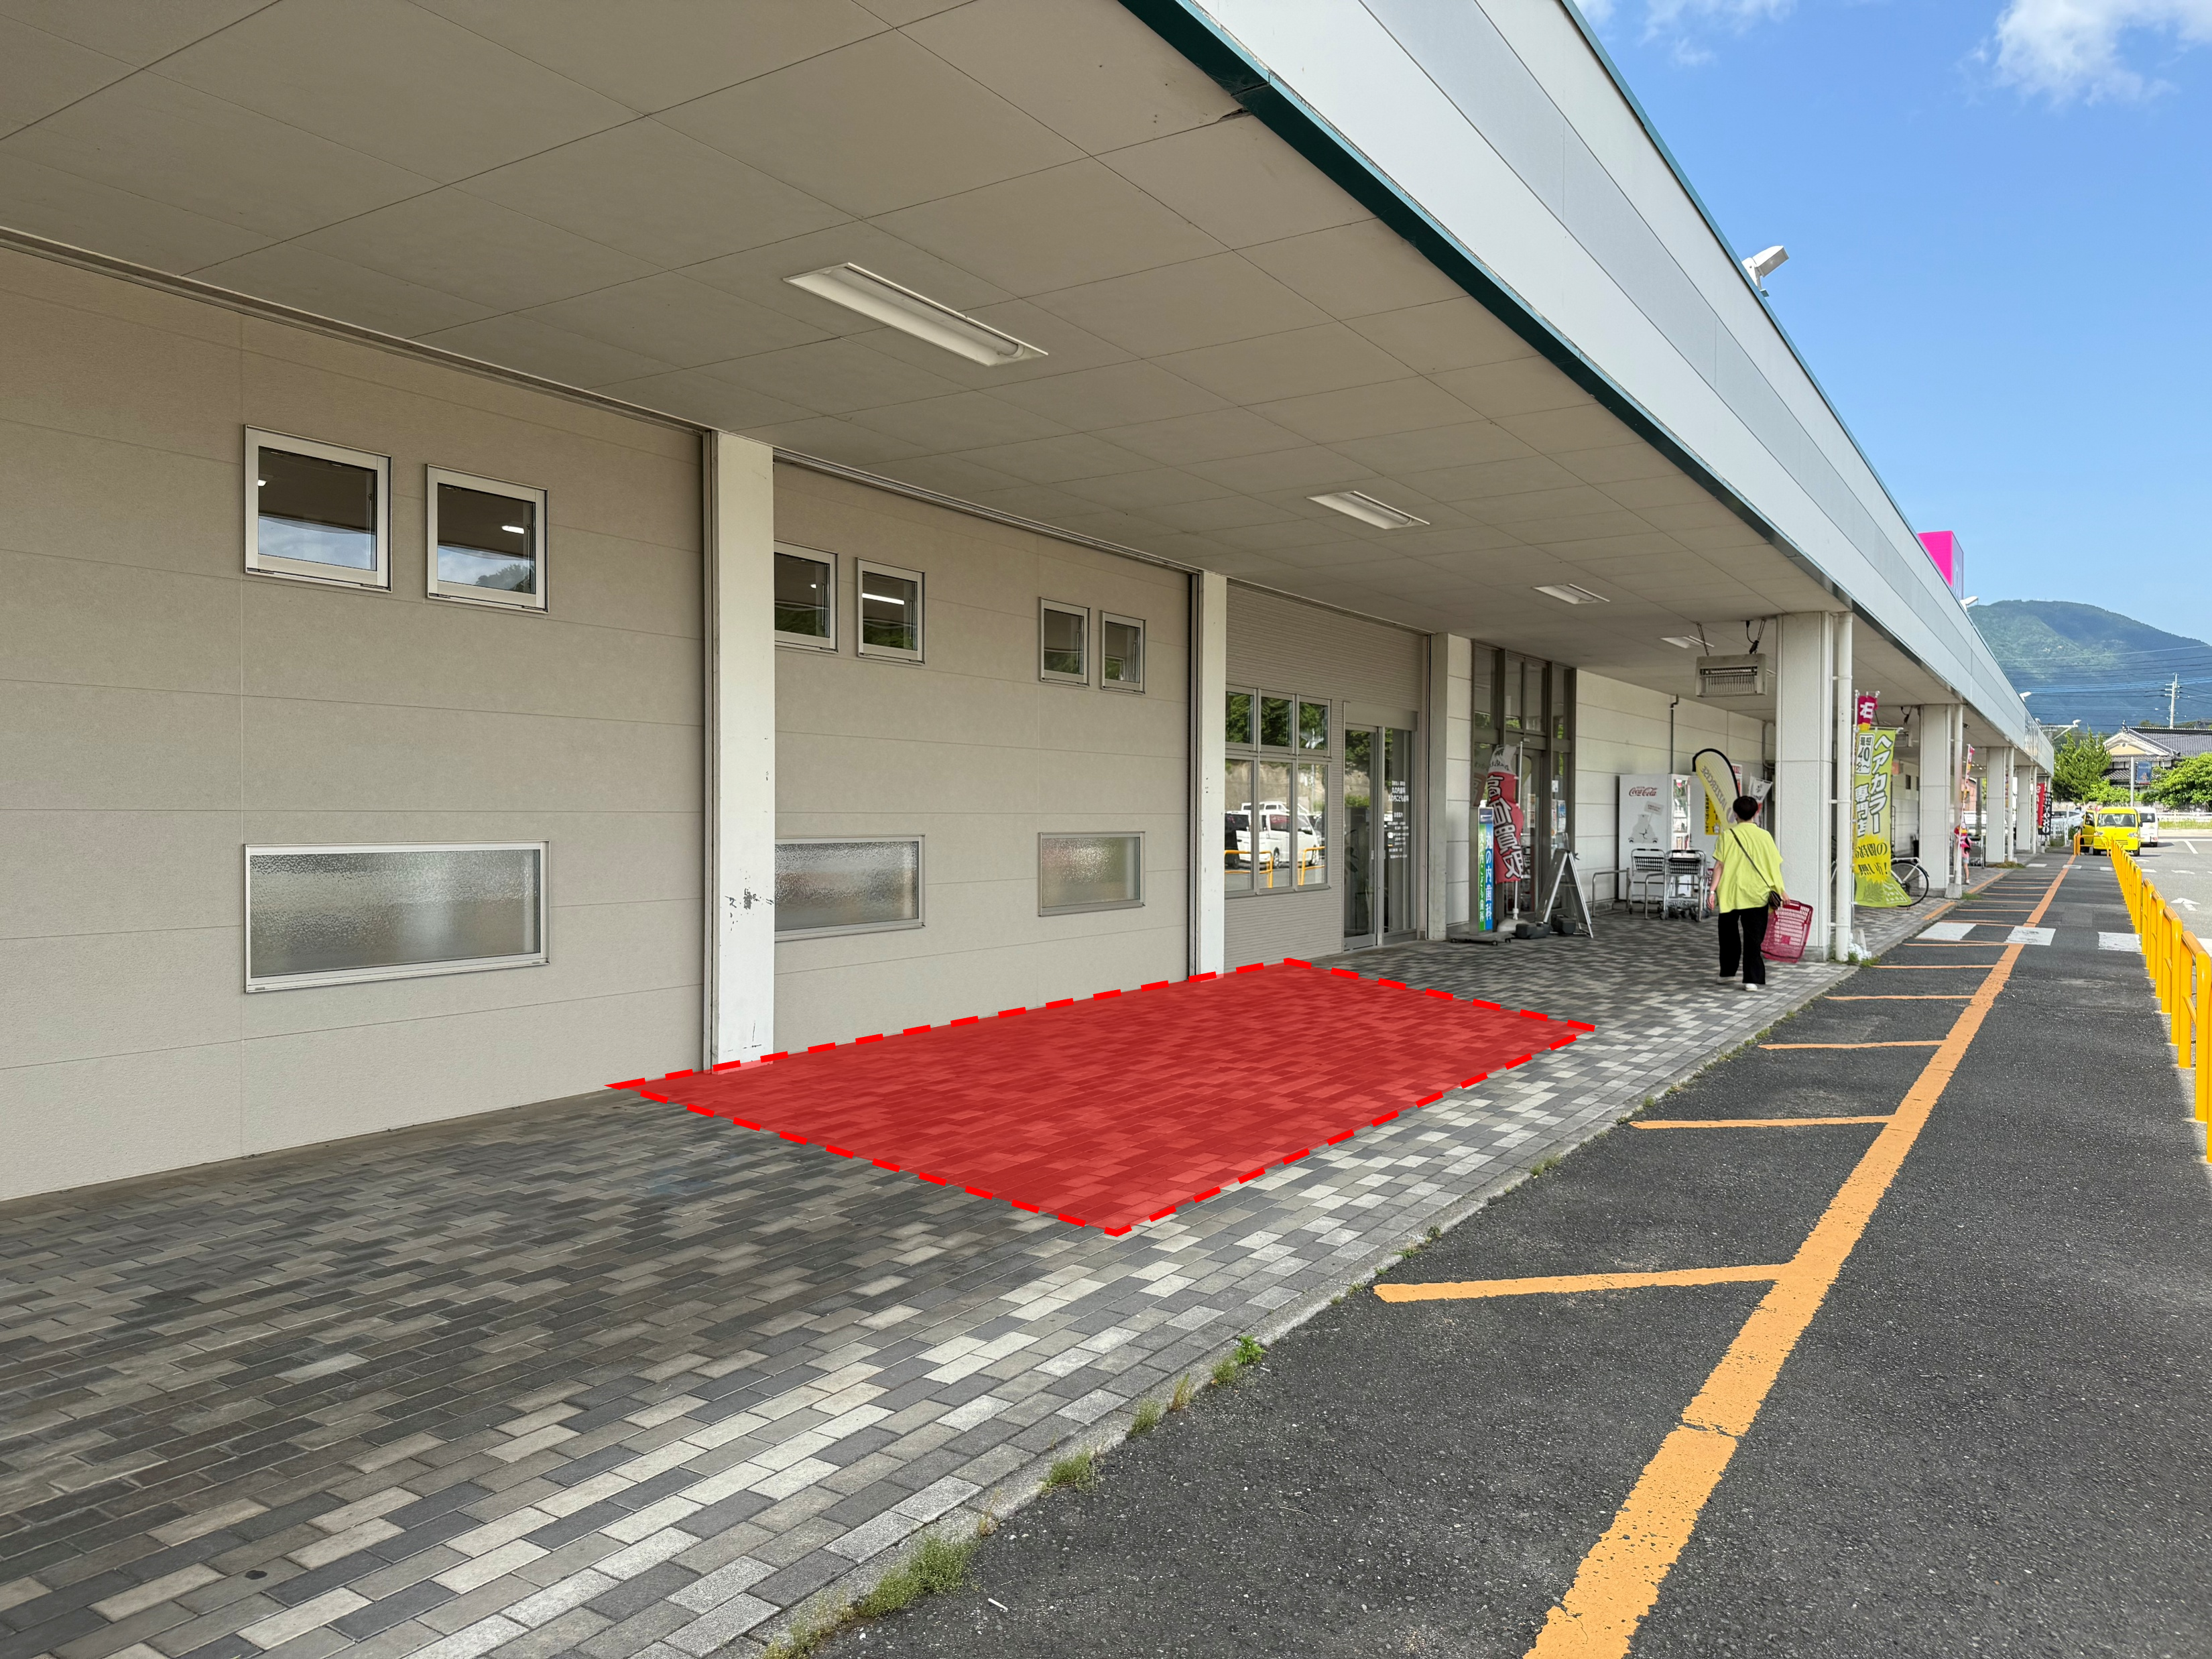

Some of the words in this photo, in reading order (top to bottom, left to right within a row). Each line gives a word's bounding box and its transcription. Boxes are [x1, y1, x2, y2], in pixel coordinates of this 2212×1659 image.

[1871, 735, 1893, 834] ヘアカラー
